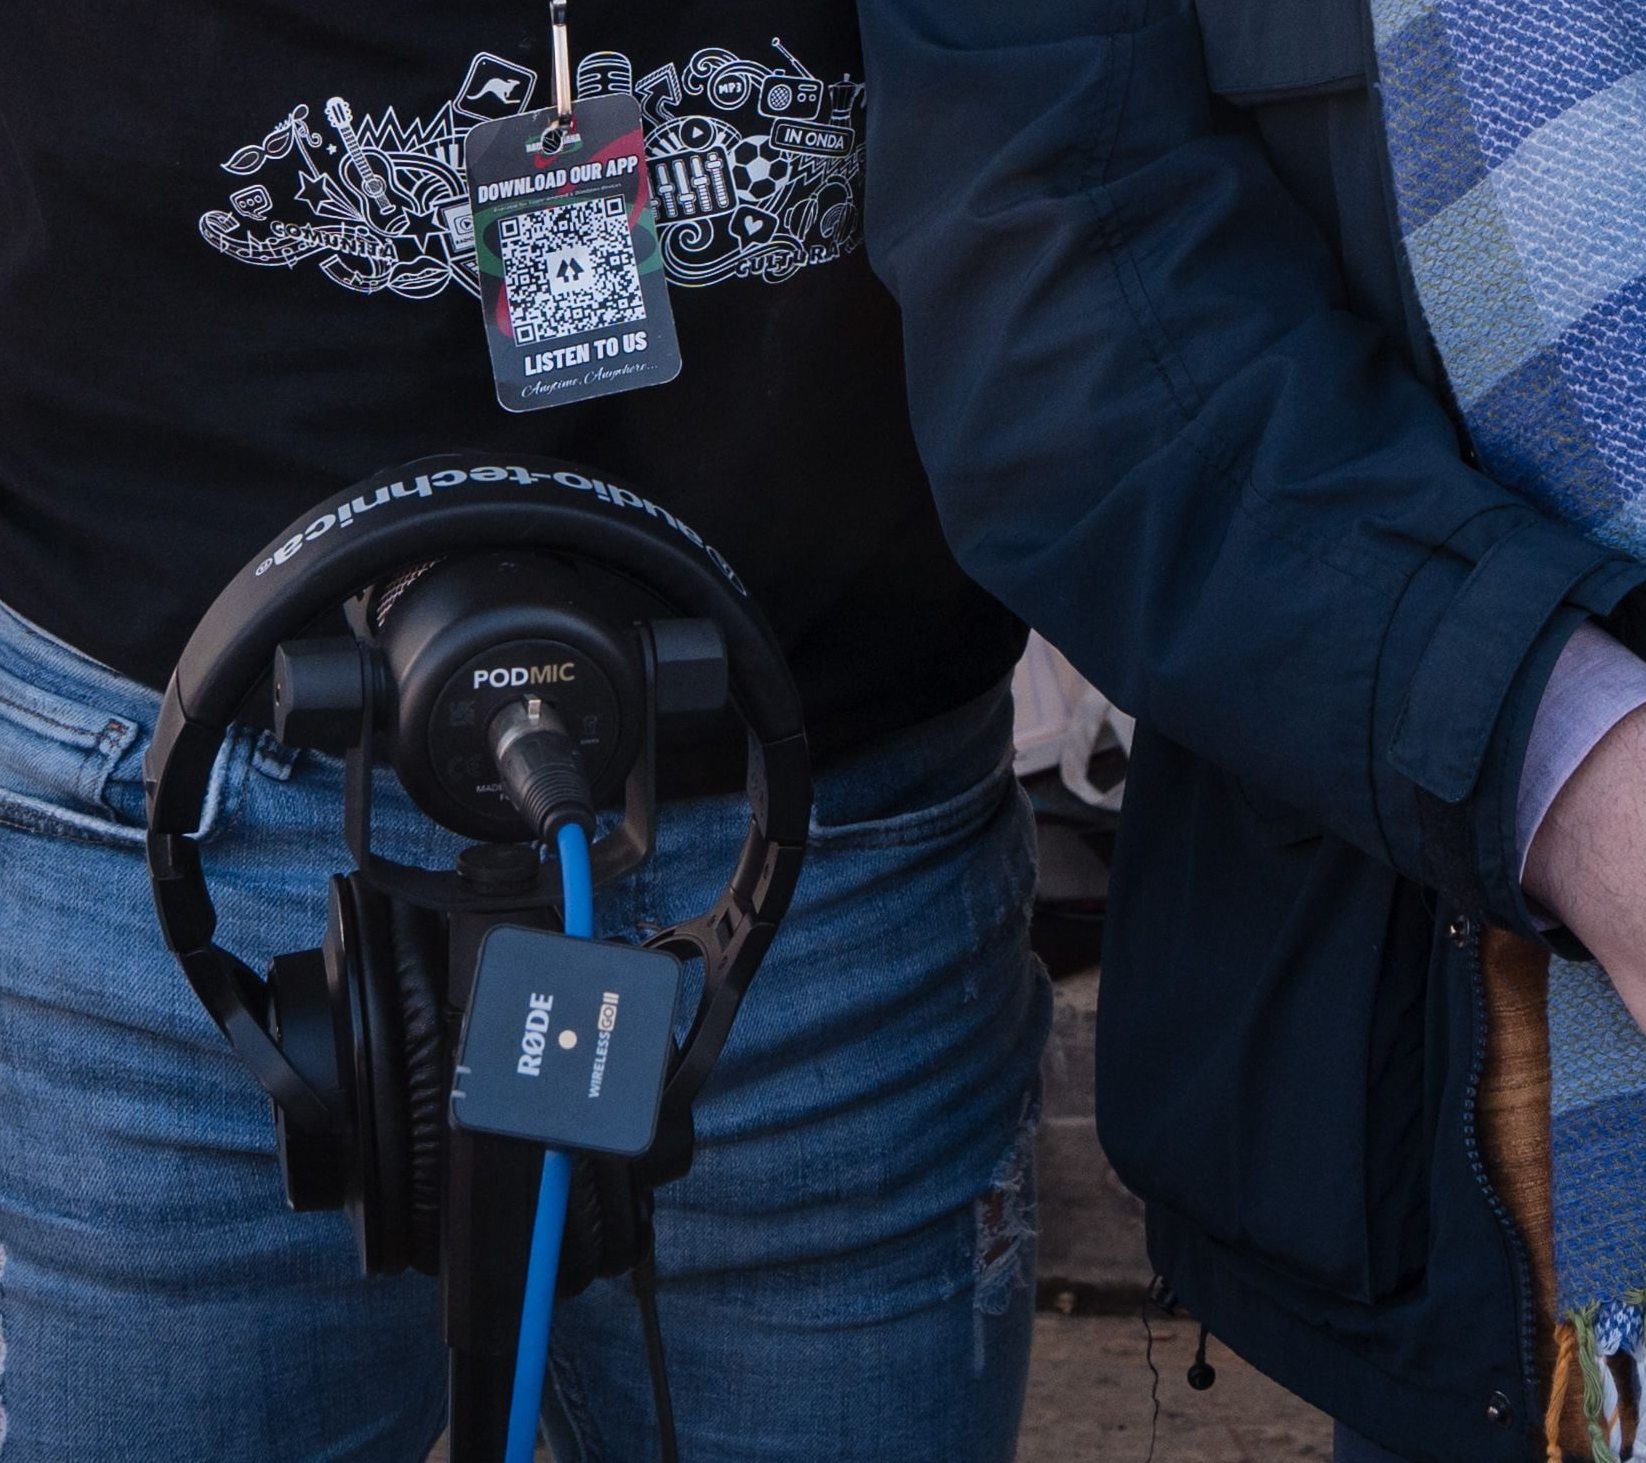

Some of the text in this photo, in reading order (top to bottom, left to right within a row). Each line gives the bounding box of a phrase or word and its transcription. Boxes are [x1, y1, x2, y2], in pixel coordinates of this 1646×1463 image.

[718, 82, 742, 94] MP3
[784, 128, 845, 150] IN ONDA
[477, 155, 639, 204] DOWNLOAD OUR APP
[735, 241, 841, 277] CULTURA
[524, 330, 648, 377] LISTEN TO US
[473, 662, 576, 690] PODMIC
[516, 991, 555, 1078] RØDE
[587, 1031, 611, 1099] WIRELESS
[599, 1005, 615, 1030] GO
